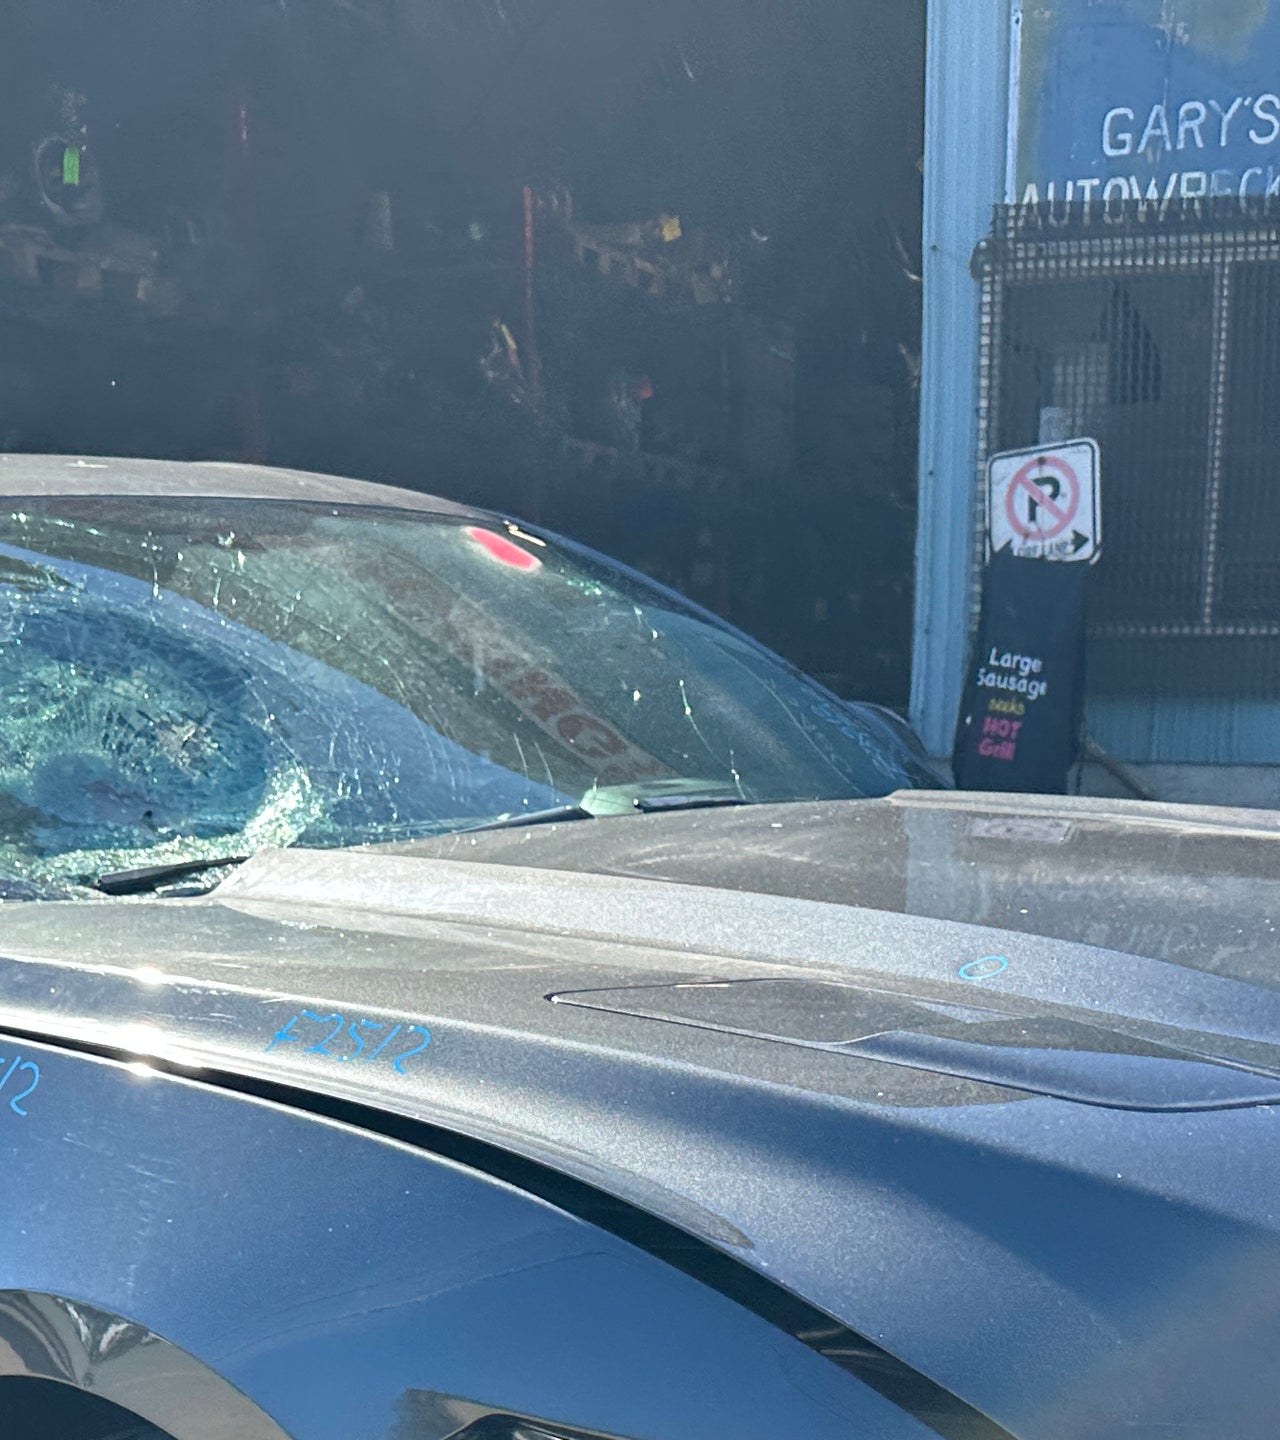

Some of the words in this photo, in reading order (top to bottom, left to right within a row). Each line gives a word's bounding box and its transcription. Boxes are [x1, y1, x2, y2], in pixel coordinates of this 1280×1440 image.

[1101, 93, 1280, 157] GARY'S
[988, 646, 1043, 677] Large
[976, 668, 1049, 701] Sausage
